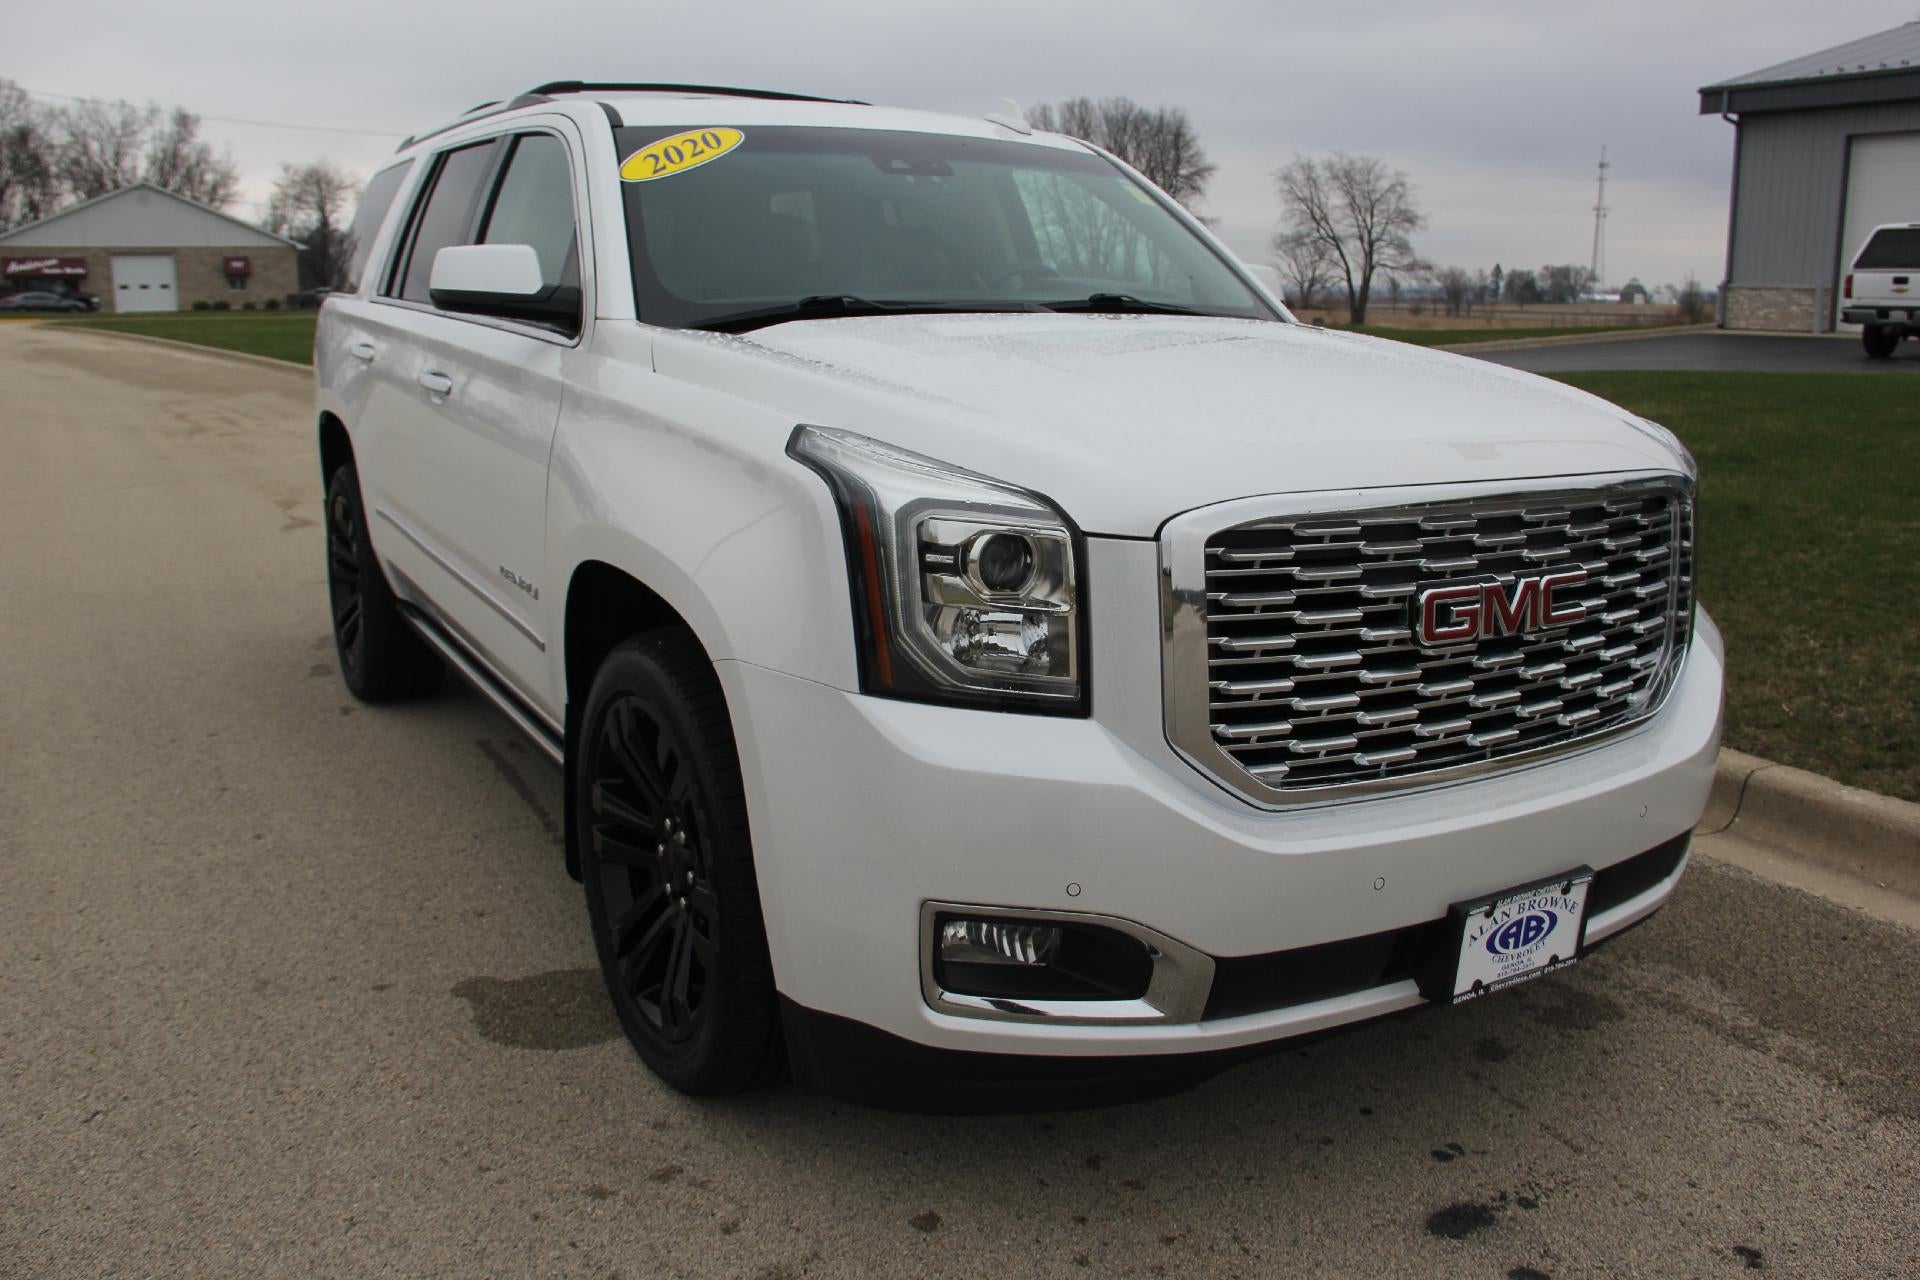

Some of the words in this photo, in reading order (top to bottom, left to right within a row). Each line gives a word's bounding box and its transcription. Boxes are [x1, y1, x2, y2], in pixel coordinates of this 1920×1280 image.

[643, 131, 722, 175] 2020
[1419, 570, 1588, 646] GMC
[1468, 909, 1511, 946] ALAN
[1517, 896, 1579, 915] BROWNE
[1492, 939, 1546, 963] CHEVROLET
